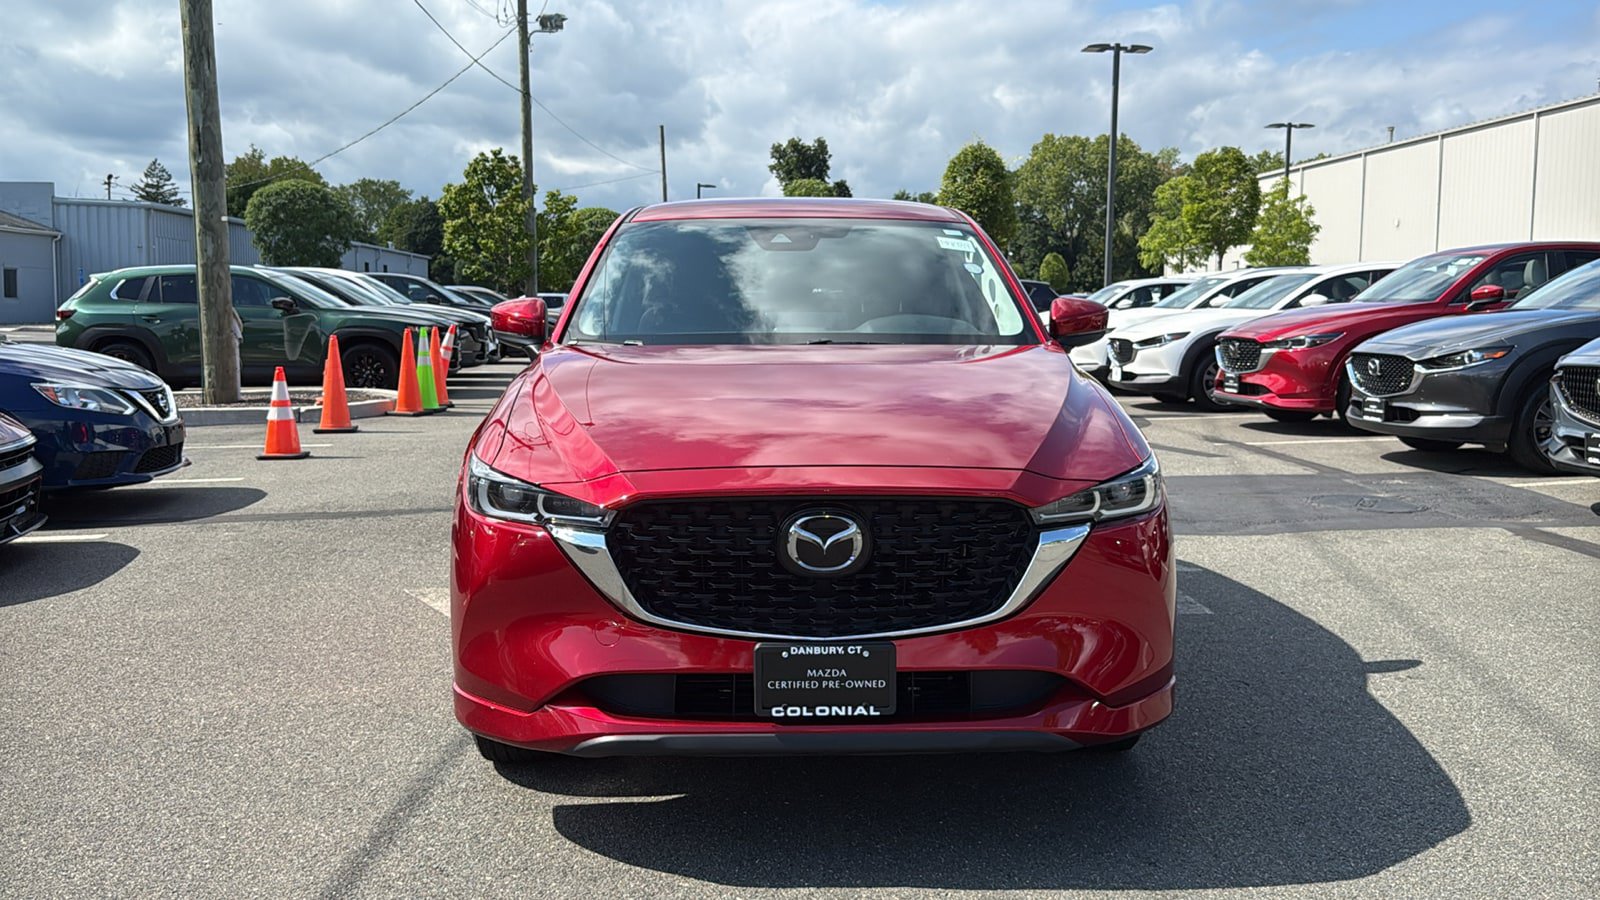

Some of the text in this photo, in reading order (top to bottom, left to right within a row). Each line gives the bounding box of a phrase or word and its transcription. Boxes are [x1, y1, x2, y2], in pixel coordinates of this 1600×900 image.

[847, 645, 862, 654] CT
[806, 669, 847, 677] MAZDA
[767, 680, 886, 689] CERTIFIED PRE-OWNED
[771, 706, 880, 716] COLONIAL
